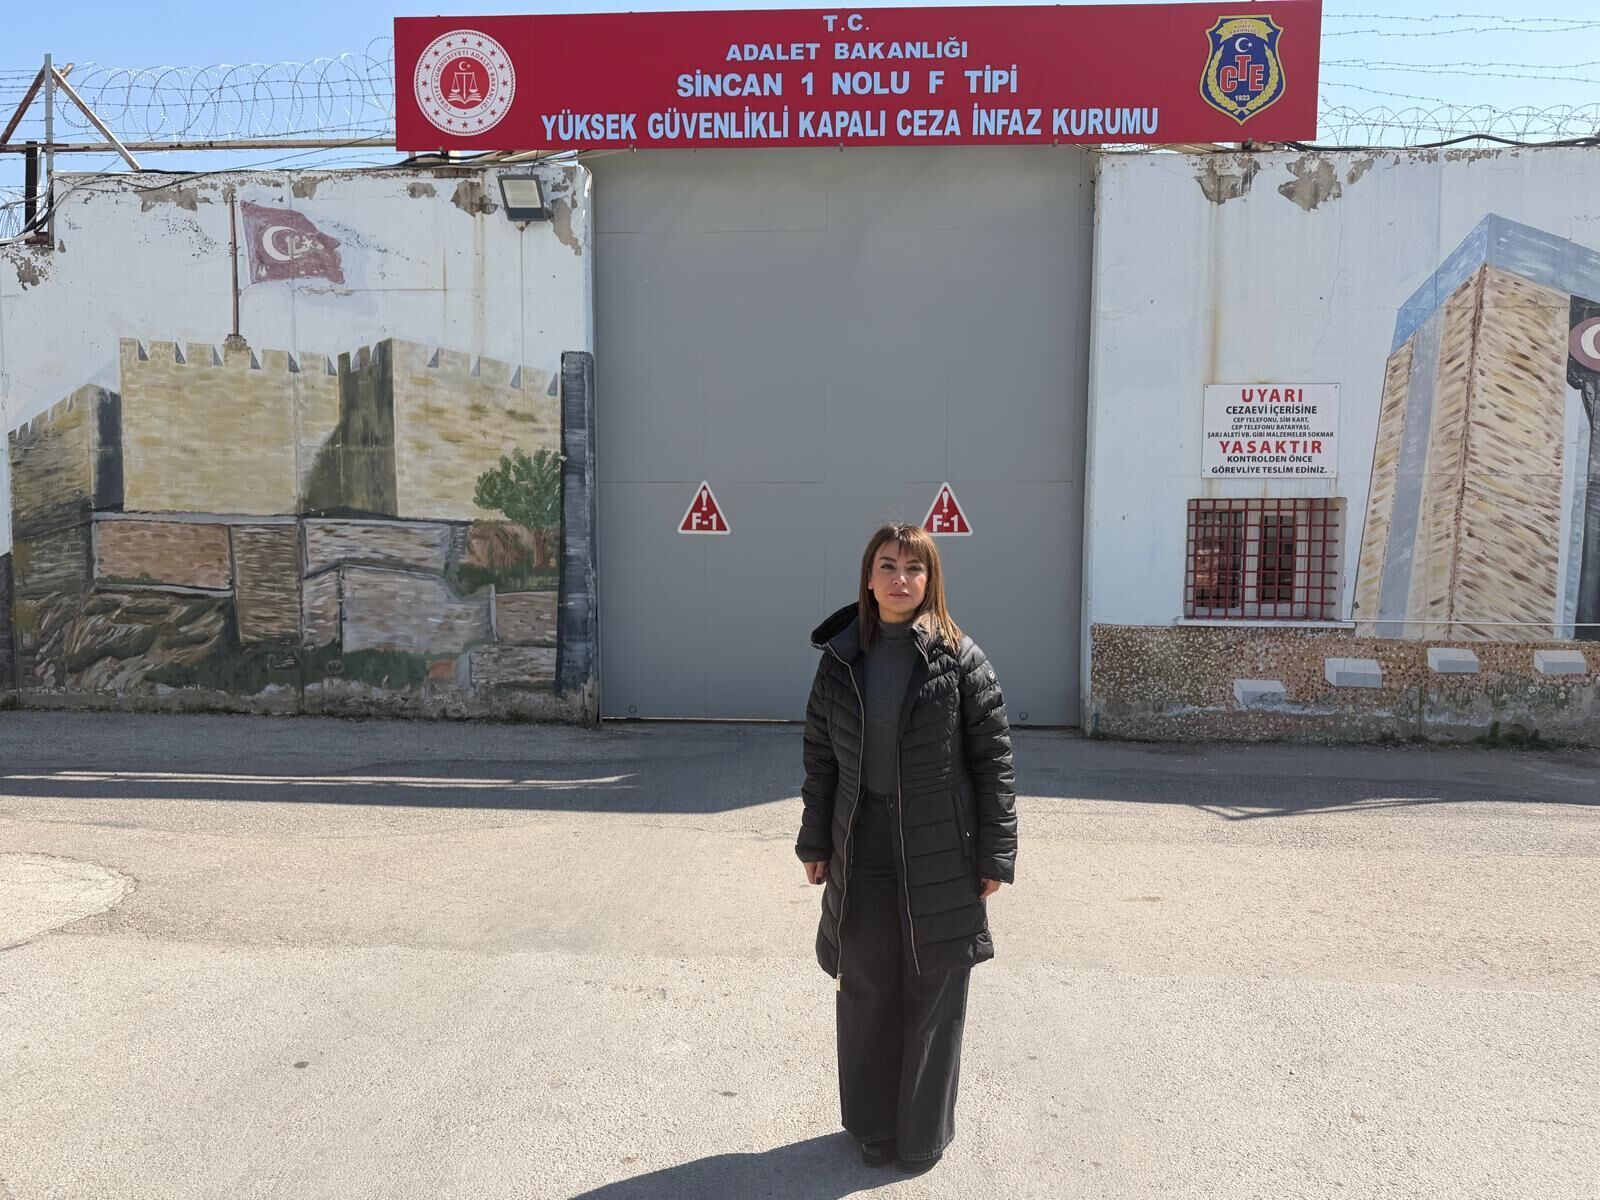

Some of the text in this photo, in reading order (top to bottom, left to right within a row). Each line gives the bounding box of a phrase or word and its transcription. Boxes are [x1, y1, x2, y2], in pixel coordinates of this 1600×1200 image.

[823, 14, 870, 31] T.C.
[726, 37, 967, 61] ADALET BAKANLIĞI
[470, 51, 493, 71] ADALET
[677, 65, 1017, 97] SİNCAN 1 NOLU F TİPİ
[1220, 55, 1264, 92] CTE
[541, 103, 1159, 141] YÜKSEK GÜVENLİKLİ KAPALI CEZA İNFAZ KURUMU
[1242, 389, 1303, 402] UYARI
[1226, 404, 1317, 416] CEZAEVİ İÇERİSİNE
[1219, 441, 1322, 453] YASAKTIR
[1289, 454, 1312, 463] ÖNCE
[1212, 465, 1327, 474] GÖREVLİYE TESLİM EDİNİZ.
[691, 512, 717, 530] F-1
[933, 514, 959, 532] F-1
